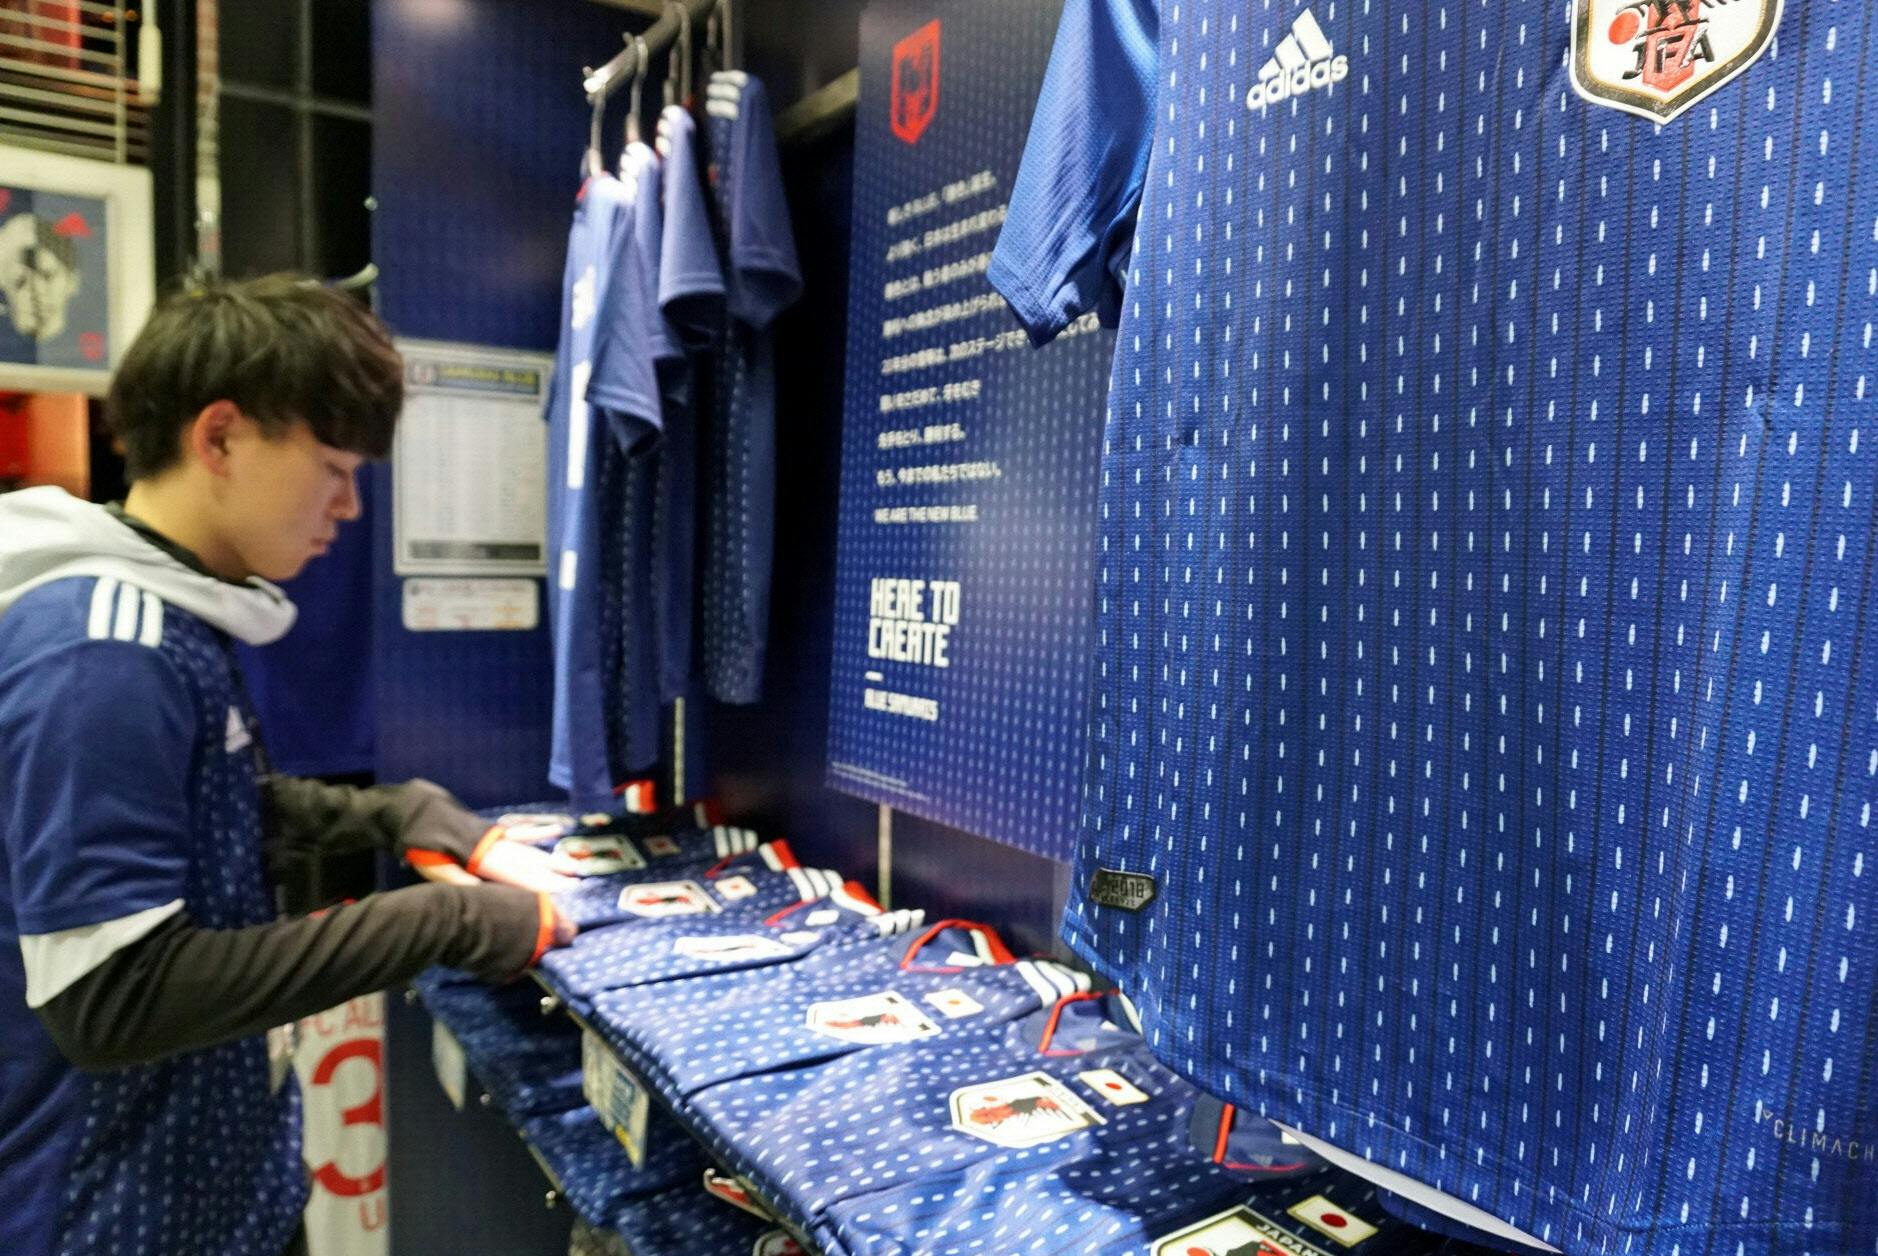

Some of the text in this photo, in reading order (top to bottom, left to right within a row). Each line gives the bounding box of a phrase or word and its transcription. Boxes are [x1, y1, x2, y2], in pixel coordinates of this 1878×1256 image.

[1621, 27, 1715, 80] JFA
[1246, 54, 1349, 111] adidas
[870, 577, 961, 625] HERE TO
[867, 617, 950, 668] CREATE
